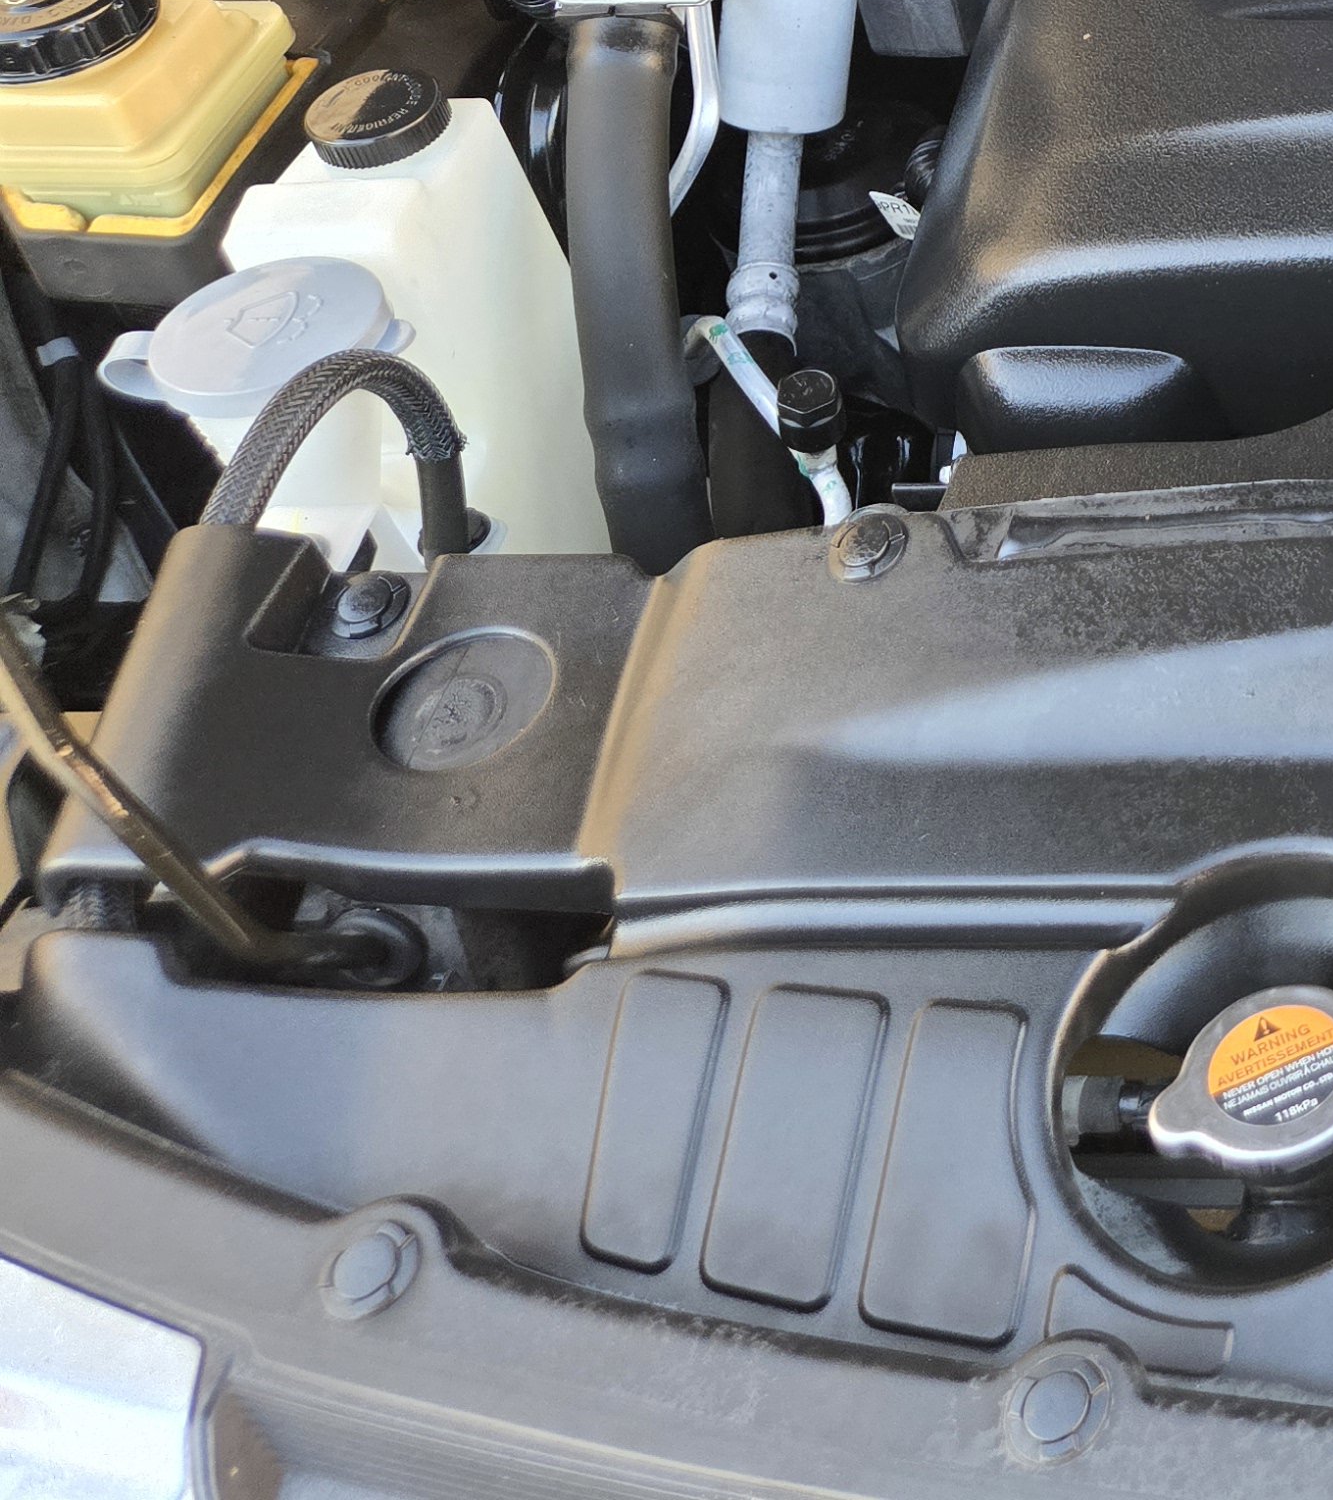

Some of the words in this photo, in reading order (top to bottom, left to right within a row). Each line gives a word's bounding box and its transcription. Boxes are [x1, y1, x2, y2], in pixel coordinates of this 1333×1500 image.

[1230, 1024, 1310, 1065] WARNING
[1223, 1080, 1255, 1099] NEVER
[1256, 1068, 1283, 1084] OPEN
[1284, 1055, 1315, 1071] WHEN
[1224, 1098, 1237, 1109] NE
[1236, 1085, 1269, 1104] JAMAIS
[1270, 1070, 1303, 1090] OUVRIR
[1243, 1099, 1273, 1116] NISSAN
[1274, 1086, 1302, 1103] MOTOR
[1274, 1098, 1318, 1122] 118kPa
